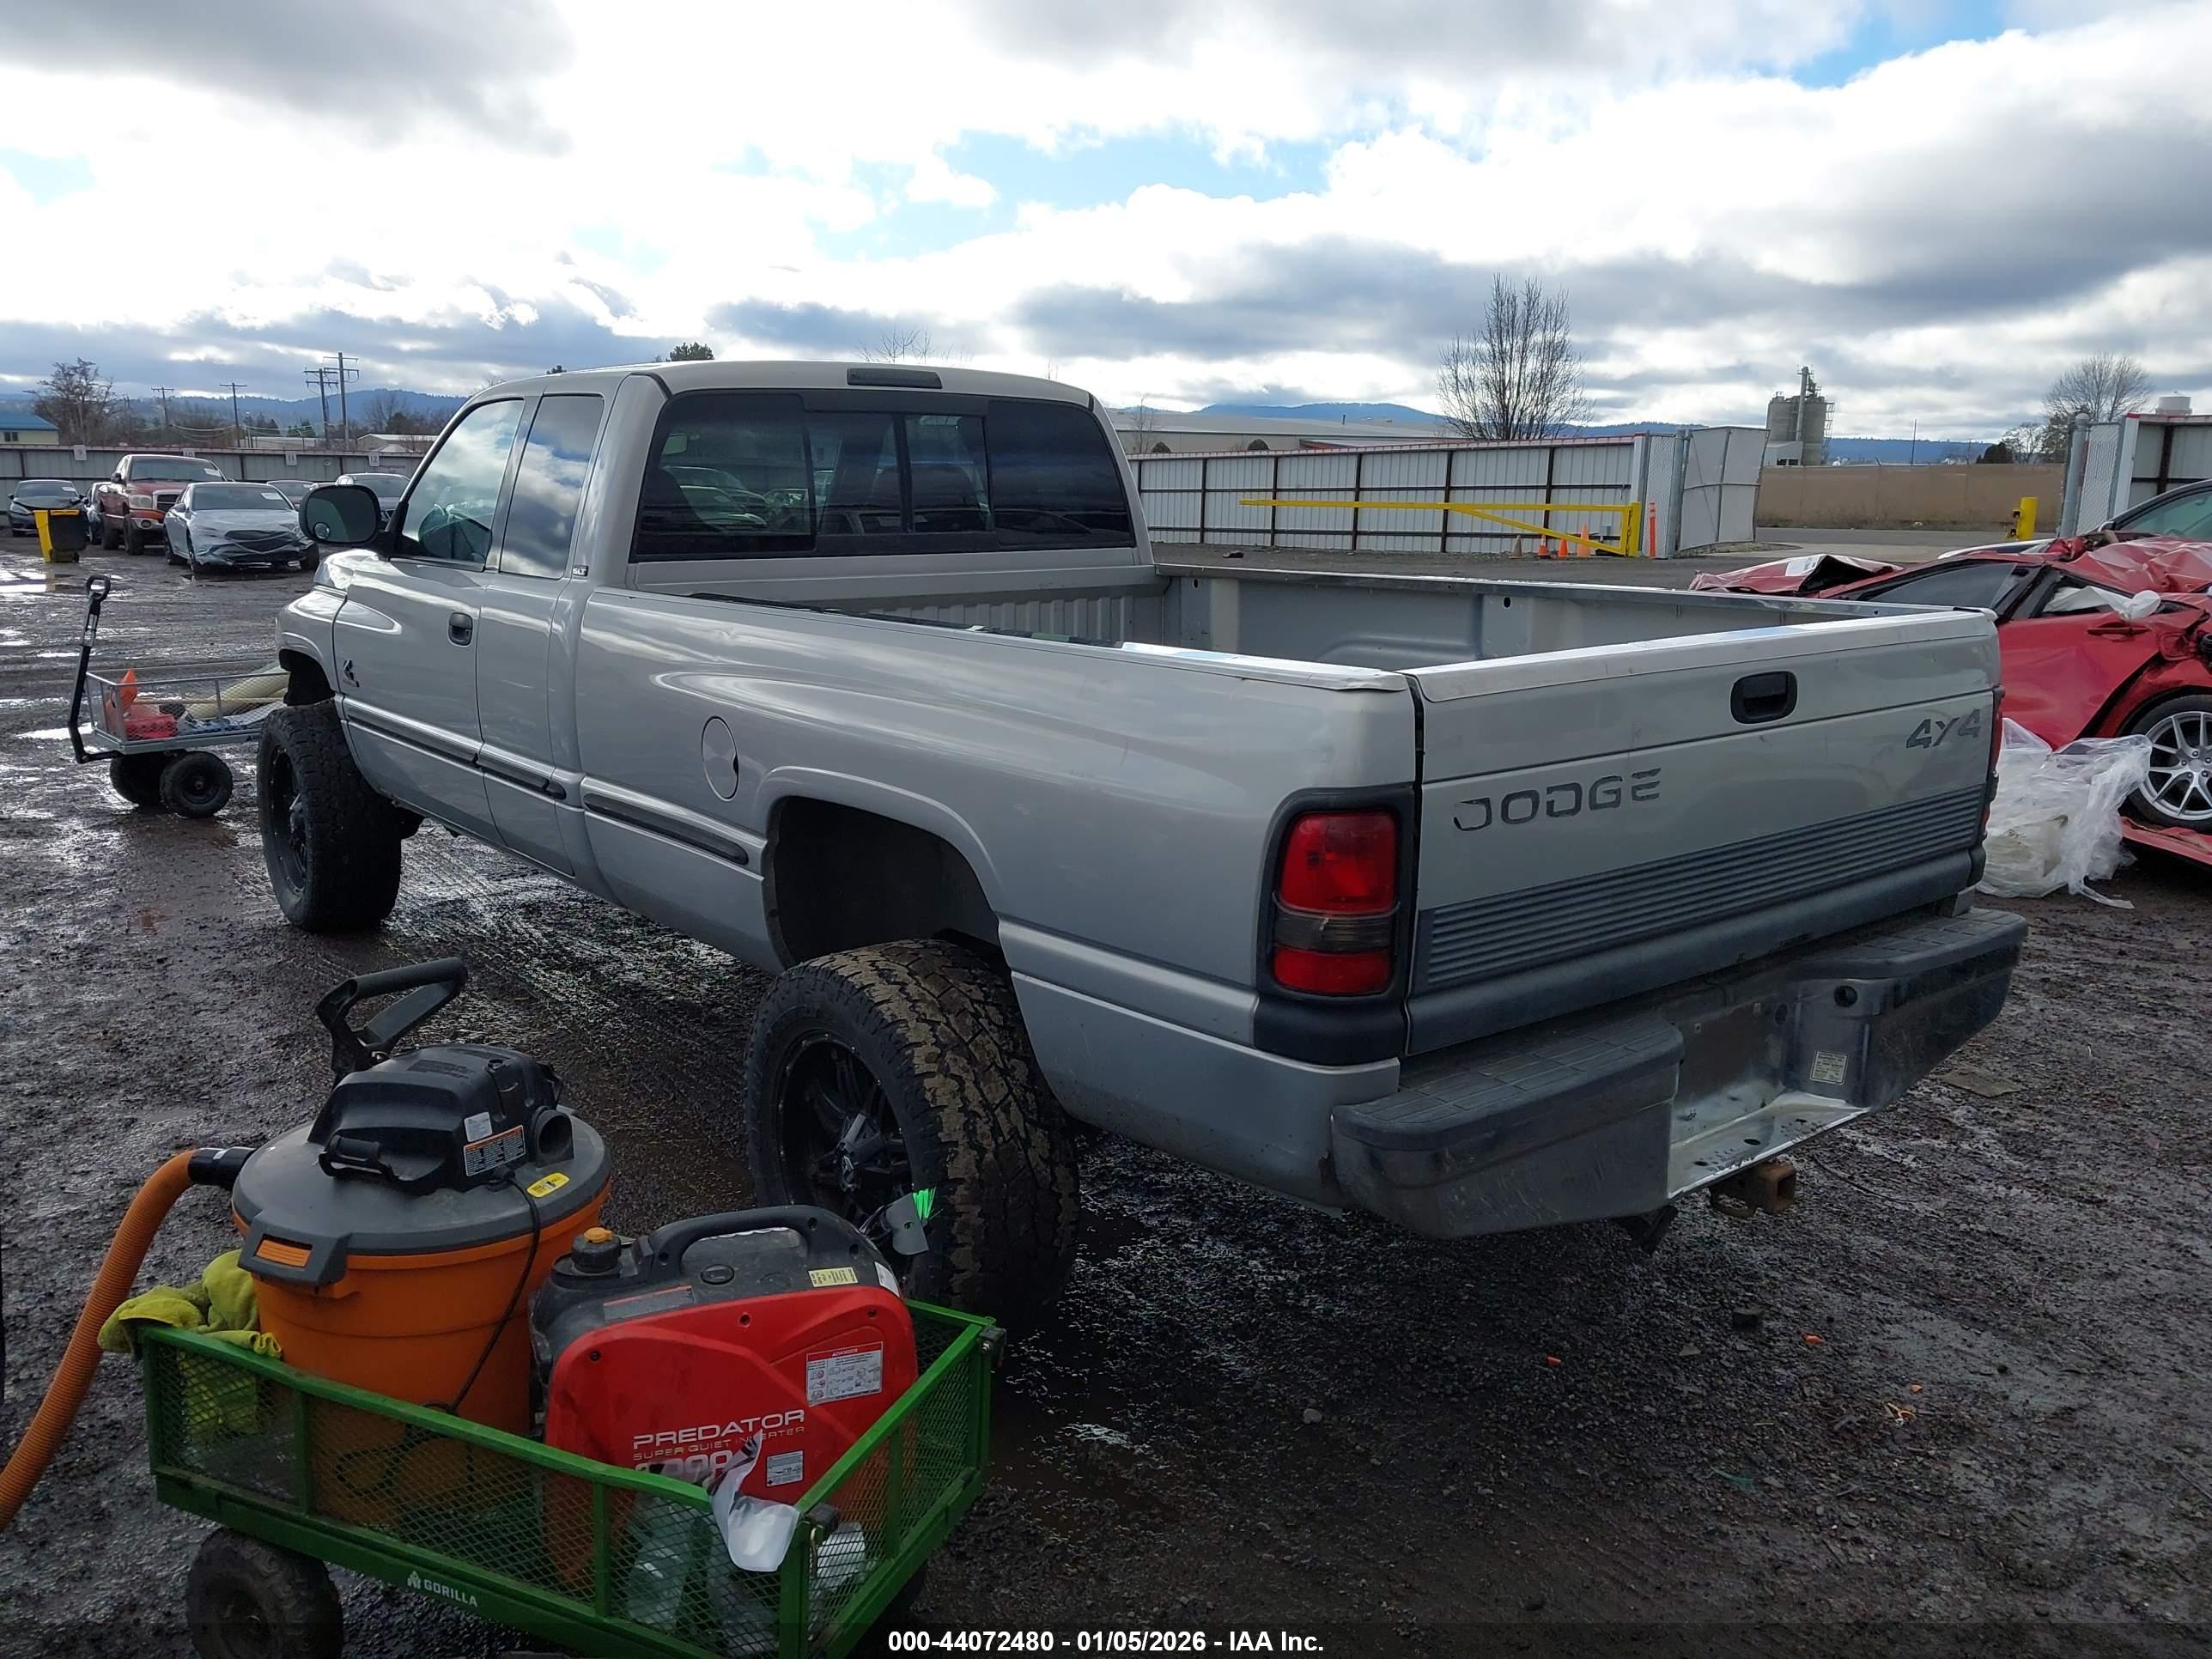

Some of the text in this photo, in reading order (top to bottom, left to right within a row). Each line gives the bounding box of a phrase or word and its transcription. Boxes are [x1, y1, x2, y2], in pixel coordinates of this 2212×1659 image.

[1453, 768, 1662, 832] DODGE
[633, 1409, 805, 1449] PREDATOR
[633, 1446, 684, 1461] SUPER
[688, 1439, 731, 1453] QUIET
[424, 1579, 477, 1607] GORILLA
